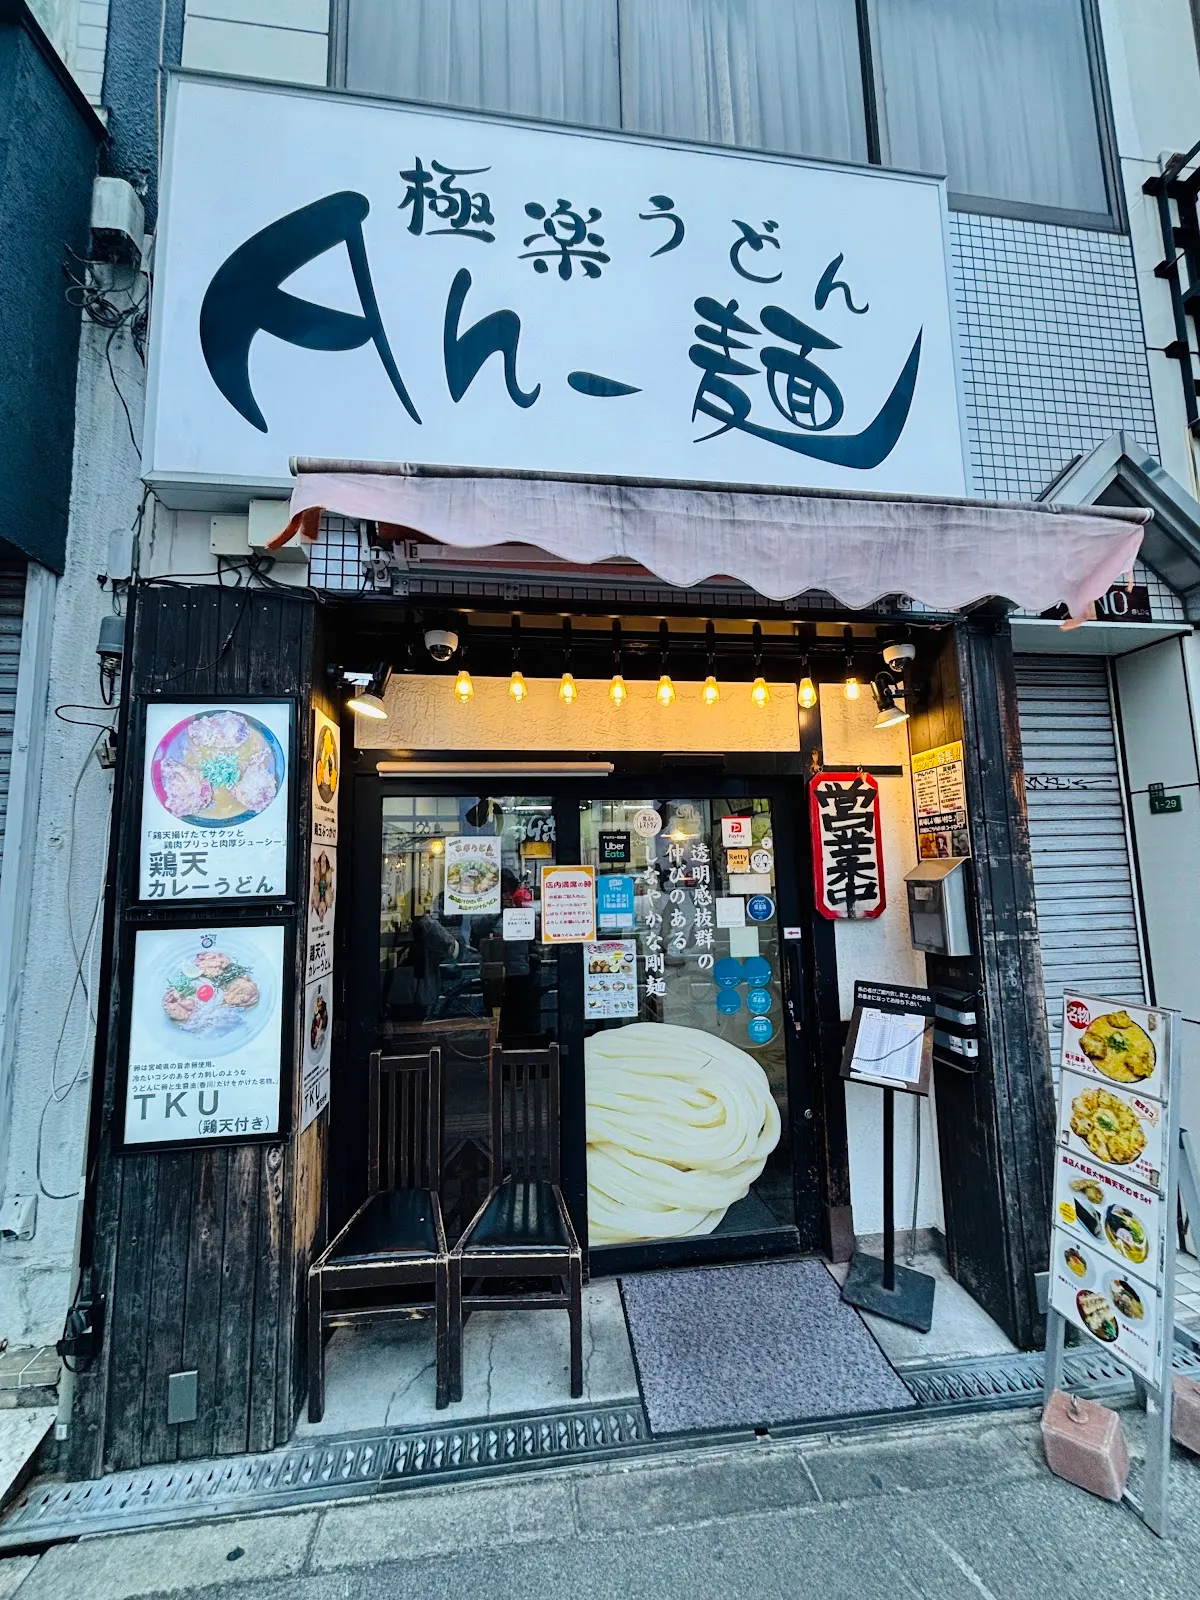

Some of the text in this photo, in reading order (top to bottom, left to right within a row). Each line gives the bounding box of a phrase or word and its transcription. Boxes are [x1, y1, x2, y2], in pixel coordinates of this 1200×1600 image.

[398, 157, 869, 314] 極楽うどん
[1155, 799, 1177, 810] 1-29
[639, 821, 658, 829] レストラン
[604, 842, 625, 851] Uber
[604, 850, 626, 859] Eats
[813, 776, 879, 918] 営業中
[149, 850, 209, 878] 鶏天
[728, 853, 748, 862] Retty
[148, 875, 275, 898] カレーうどん
[545, 880, 592, 889] 店内満席の時
[665, 843, 687, 950] 伸びのある
[690, 842, 716, 970] 透明感抜群の
[643, 845, 668, 998] しなやかな剛麺
[1067, 1006, 1091, 1026] 名物
[1065, 1059, 1098, 1074] カレーうどん
[133, 1089, 219, 1120] TKU
[304, 1081, 321, 1112] TKU
[198, 1115, 270, 1135] (鶏天付き)
